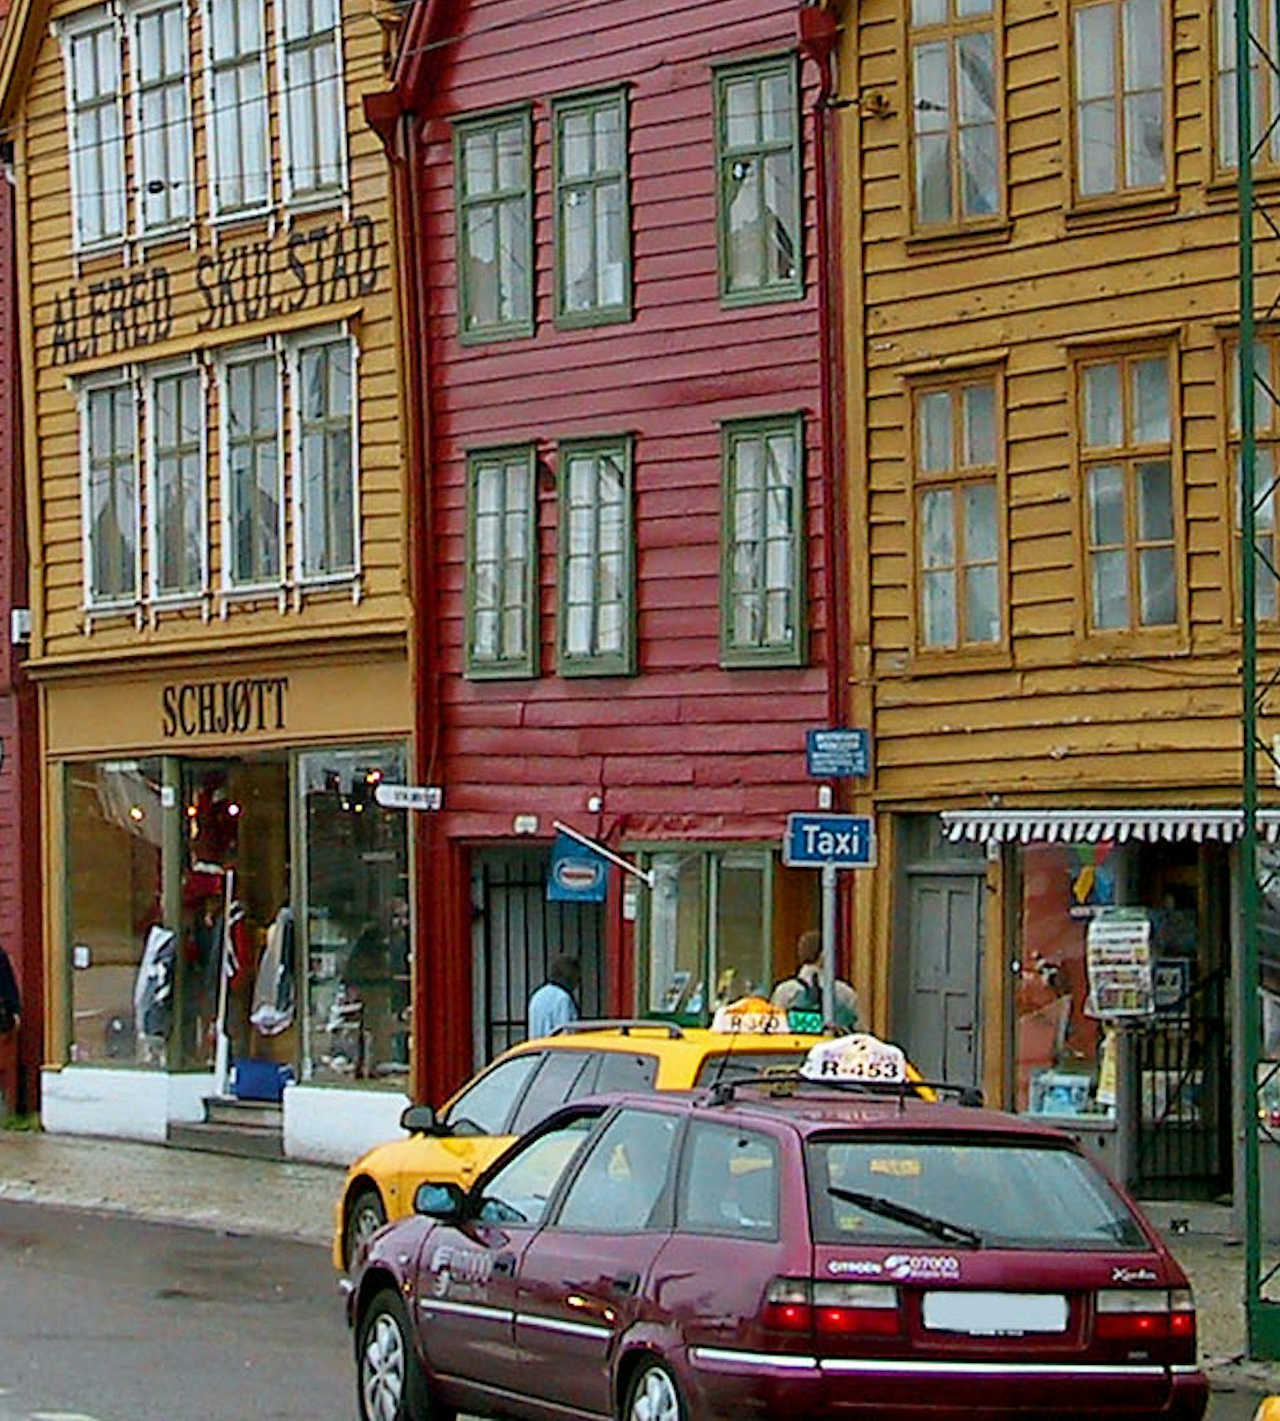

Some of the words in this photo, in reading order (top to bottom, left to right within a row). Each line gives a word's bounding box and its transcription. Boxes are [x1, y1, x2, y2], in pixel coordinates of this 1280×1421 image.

[53, 265, 172, 366] ALFRED
[162, 676, 289, 737] SCHJØTT
[801, 823, 860, 855] Taxi
[821, 1061, 899, 1078] R-453
